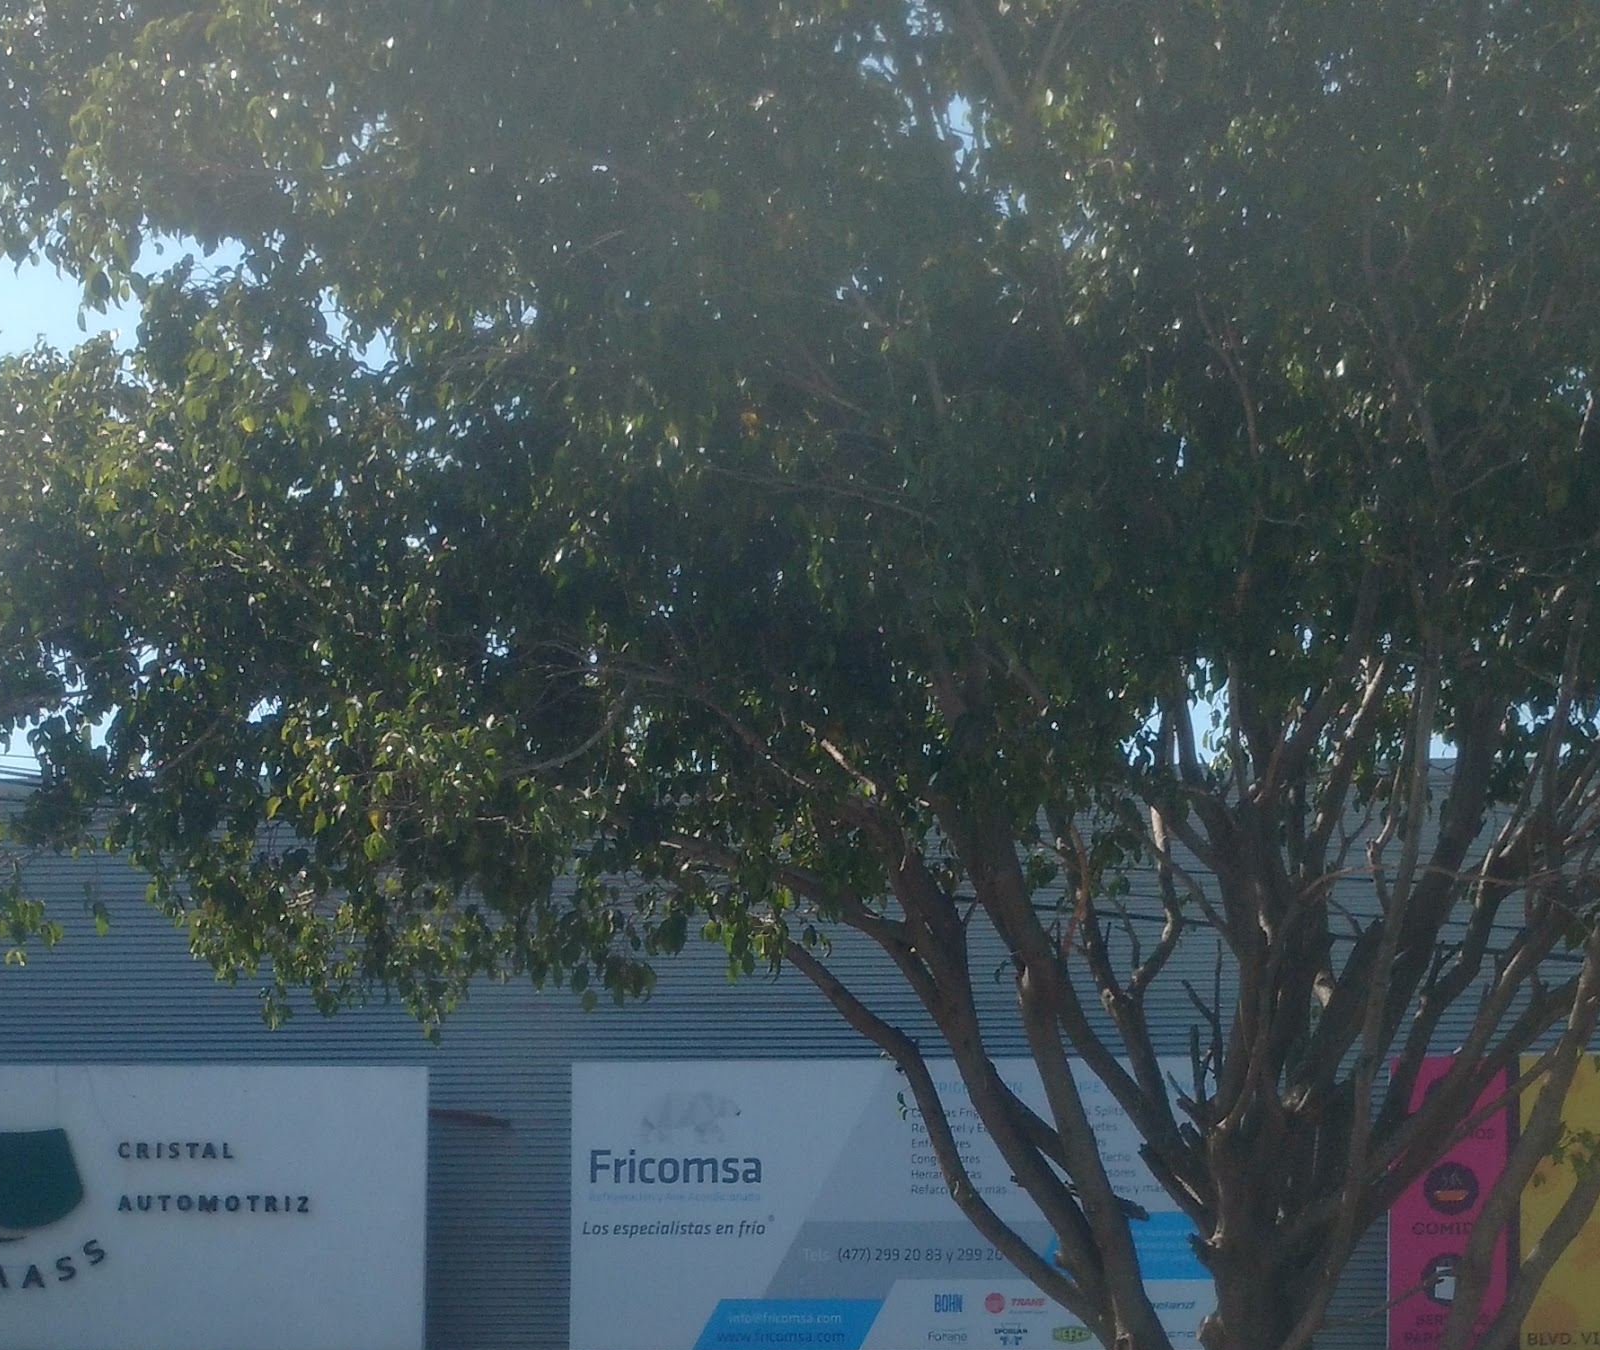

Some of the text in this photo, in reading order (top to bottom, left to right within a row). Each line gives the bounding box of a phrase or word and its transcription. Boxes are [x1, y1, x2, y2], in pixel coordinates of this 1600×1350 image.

[116, 1141, 236, 1160] CRISTAL
[589, 1148, 762, 1184] Fricomsa
[116, 1193, 312, 1215] AUTOMOTRIZ
[582, 1221, 609, 1235] Los
[613, 1220, 711, 1239] especialistas
[715, 1224, 734, 1235] en
[1412, 1221, 1474, 1236] COMID
[837, 1247, 871, 1262] (477)
[875, 1248, 900, 1261] 299
[903, 1248, 920, 1261] 20
[925, 1248, 942, 1261] 83
[945, 1251, 954, 1264] y
[957, 1248, 983, 1261] 299
[934, 1293, 963, 1313] BOHN
[1011, 1297, 1046, 1308] TRANE
[728, 1311, 842, 1325] info@fricomsa.com
[717, 1330, 845, 1343] www.fricomsa.com
[1526, 1330, 1578, 1347] BLVD.
